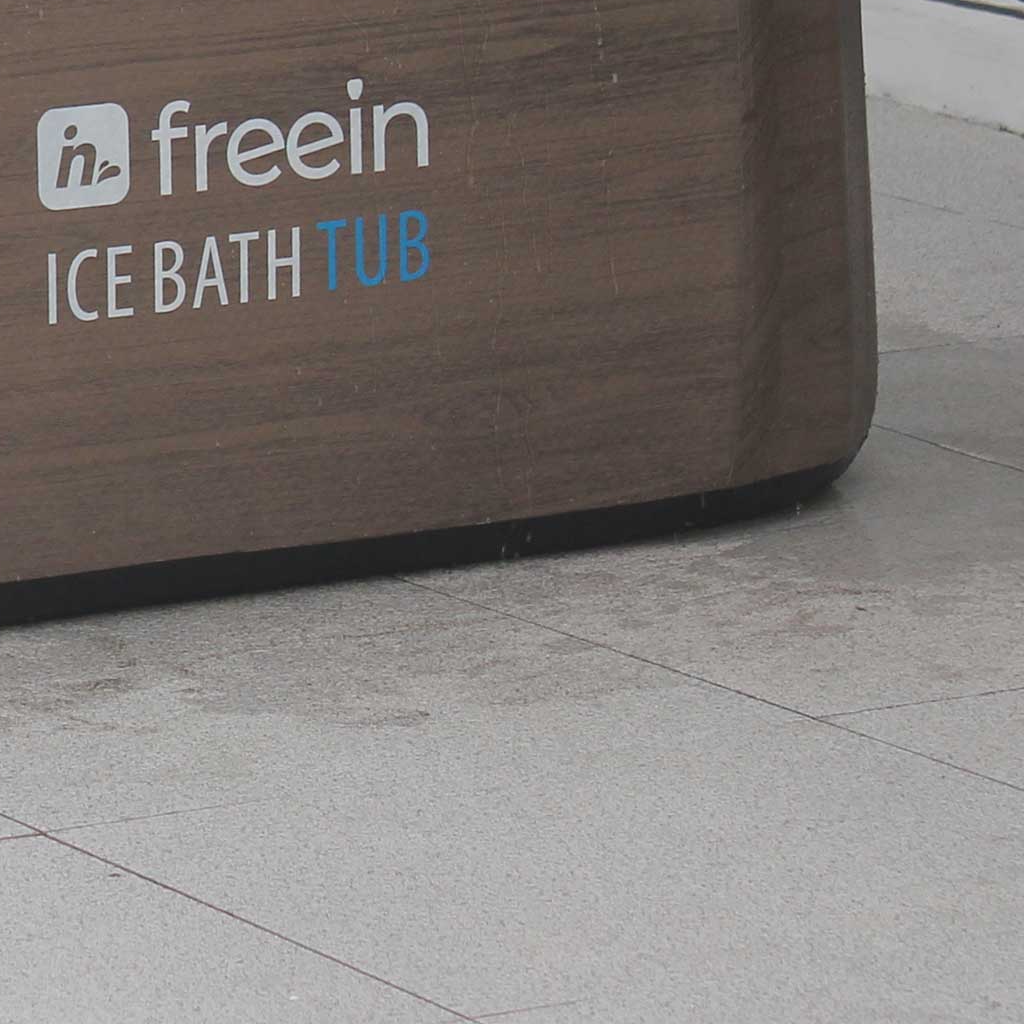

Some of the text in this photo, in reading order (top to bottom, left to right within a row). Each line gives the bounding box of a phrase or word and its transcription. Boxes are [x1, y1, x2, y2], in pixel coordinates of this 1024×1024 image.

[151, 78, 430, 196] freein
[47, 209, 432, 325] ICE BATH TUB
